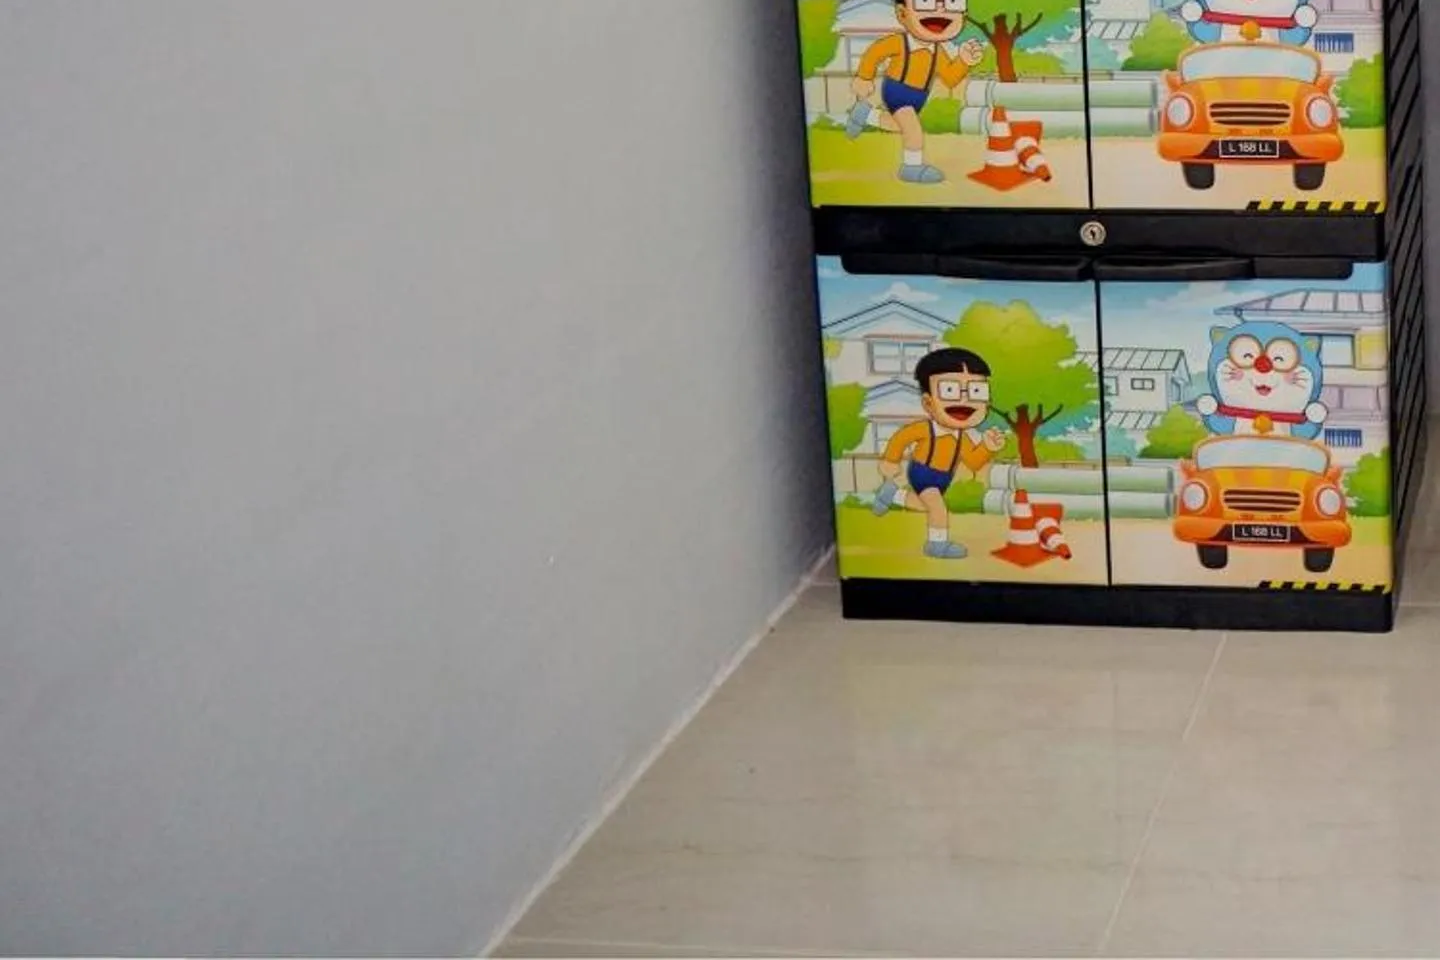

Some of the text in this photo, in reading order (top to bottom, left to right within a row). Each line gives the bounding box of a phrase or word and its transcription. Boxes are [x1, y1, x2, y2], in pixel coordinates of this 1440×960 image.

[1228, 142, 1236, 153] L
[1258, 142, 1272, 153] LL
[1241, 526, 1248, 537] L
[1270, 527, 1283, 538] LL
